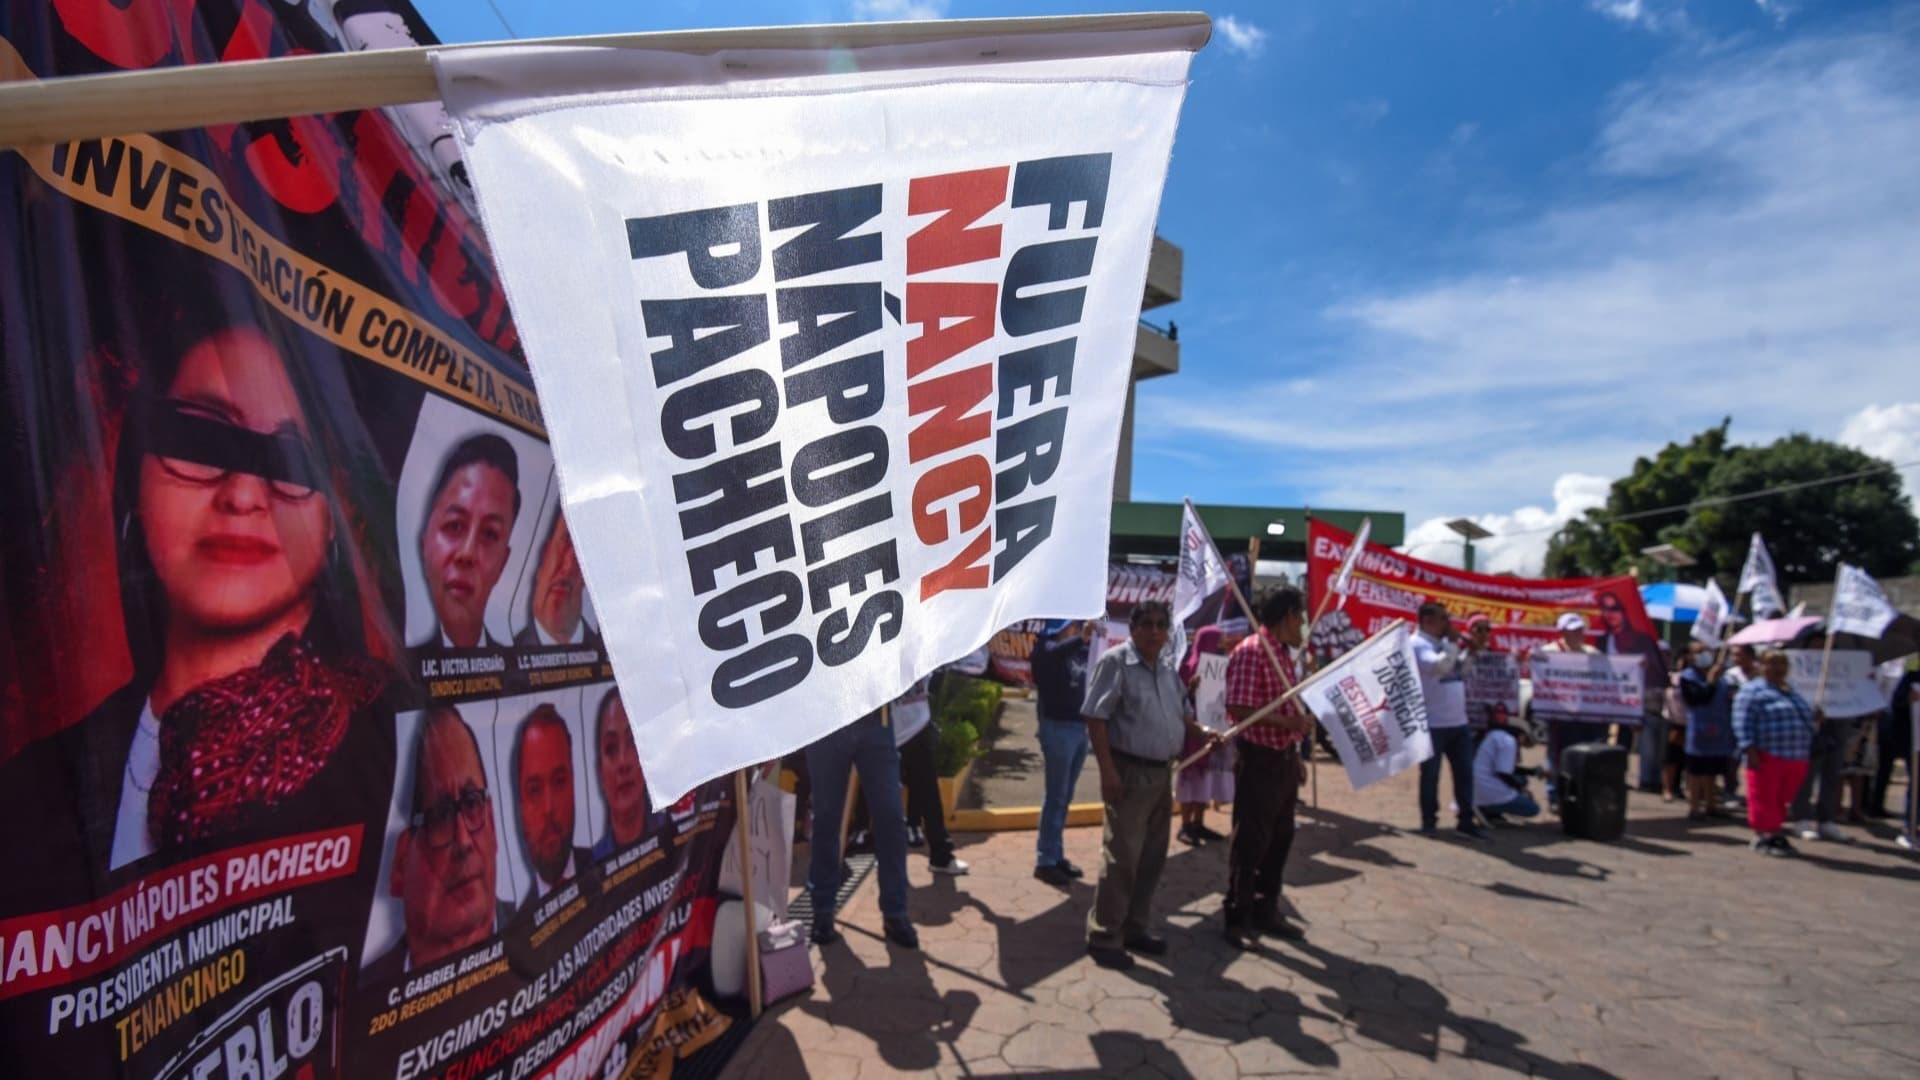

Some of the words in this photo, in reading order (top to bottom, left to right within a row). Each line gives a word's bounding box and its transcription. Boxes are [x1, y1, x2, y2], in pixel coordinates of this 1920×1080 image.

[503, 383, 545, 425] TRA
[767, 182, 904, 668] NÁPOLES
[906, 165, 1011, 604] NANCY
[992, 152, 1112, 586] FUERA
[624, 202, 814, 710] PACHECO
[0, 907, 117, 983] ANCY
[121, 880, 219, 944] NÁPOLES
[224, 834, 351, 896] PACHECO
[49, 943, 184, 1036] PRESIDENTA
[188, 895, 296, 963] MUNICIPAL
[404, 962, 457, 999] GABRIEL
[115, 949, 246, 1063] TENANCINGO
[369, 1008, 398, 1037] 2DO
[400, 983, 454, 1021] REGIDOR
[396, 999, 508, 1080] EXIGIMOS
[511, 973, 547, 1018] QUE
[549, 951, 574, 993] LAS
[573, 895, 643, 972] AUTORIDADES
[510, 1020, 572, 1080] DEBIDO
[572, 970, 629, 1037] PROCESO
